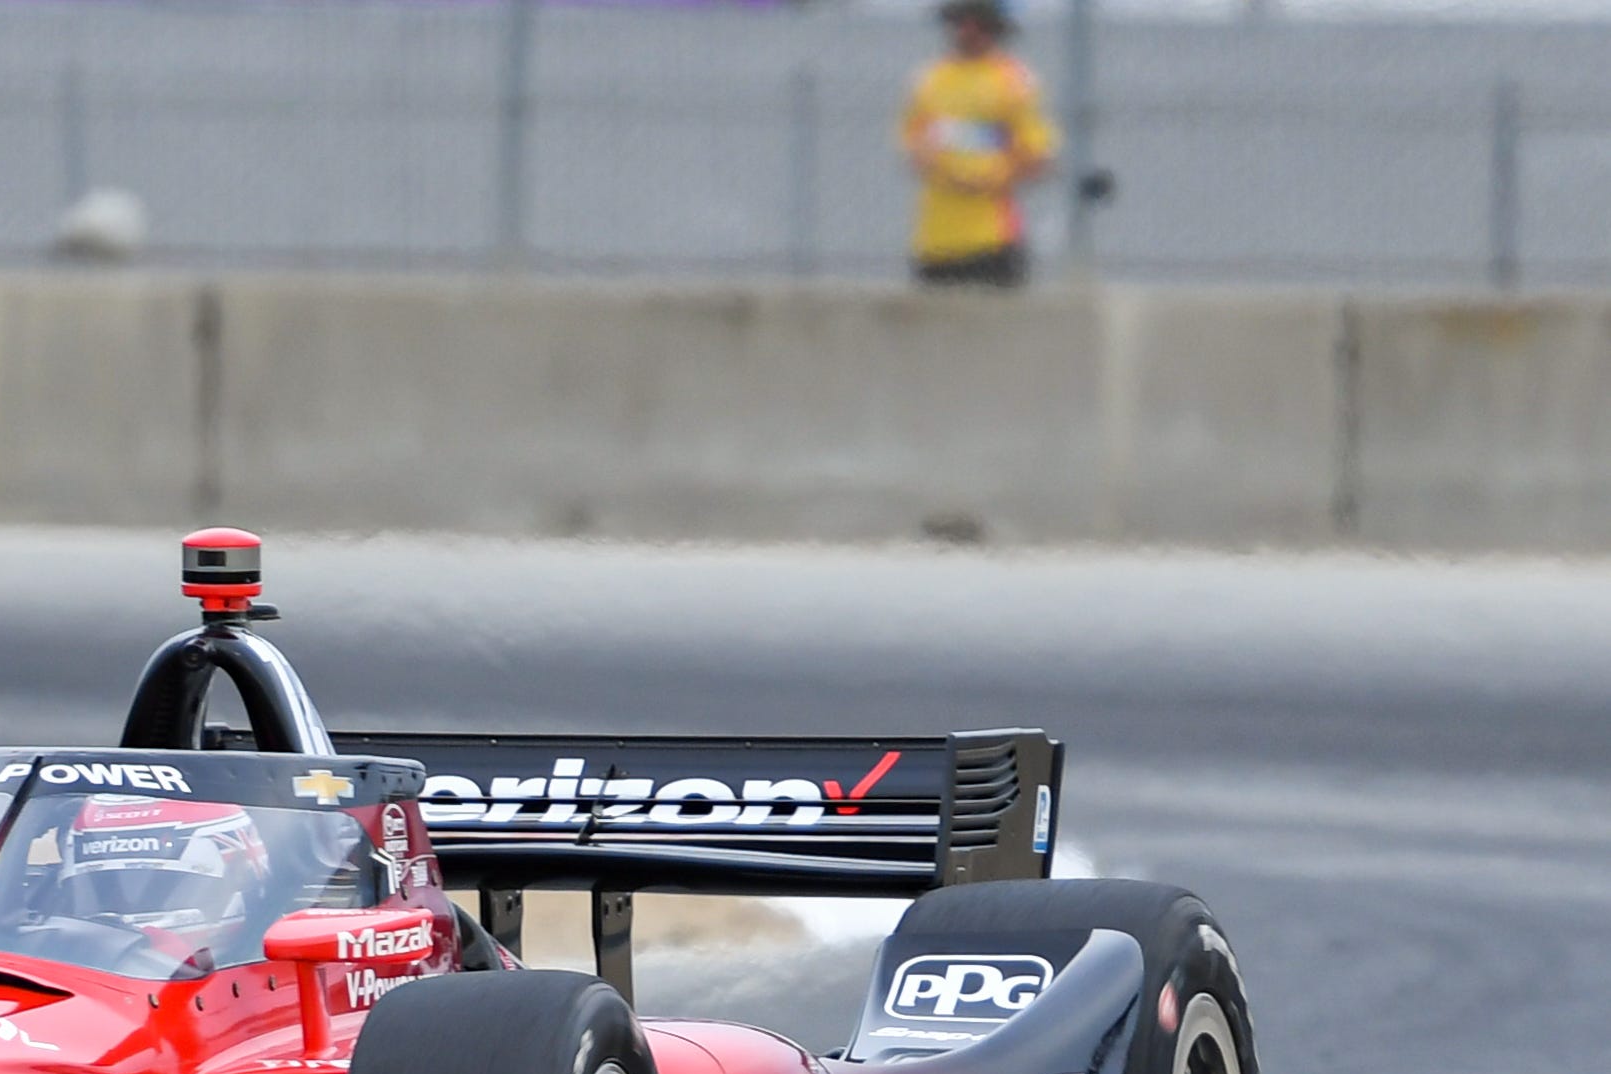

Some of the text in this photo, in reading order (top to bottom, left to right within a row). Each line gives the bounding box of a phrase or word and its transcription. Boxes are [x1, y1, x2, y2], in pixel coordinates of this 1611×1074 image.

[417, 758, 823, 826] erizon
[82, 836, 160, 855] verizon
[337, 919, 433, 959] Mazak
[897, 964, 1041, 1015] PPG
